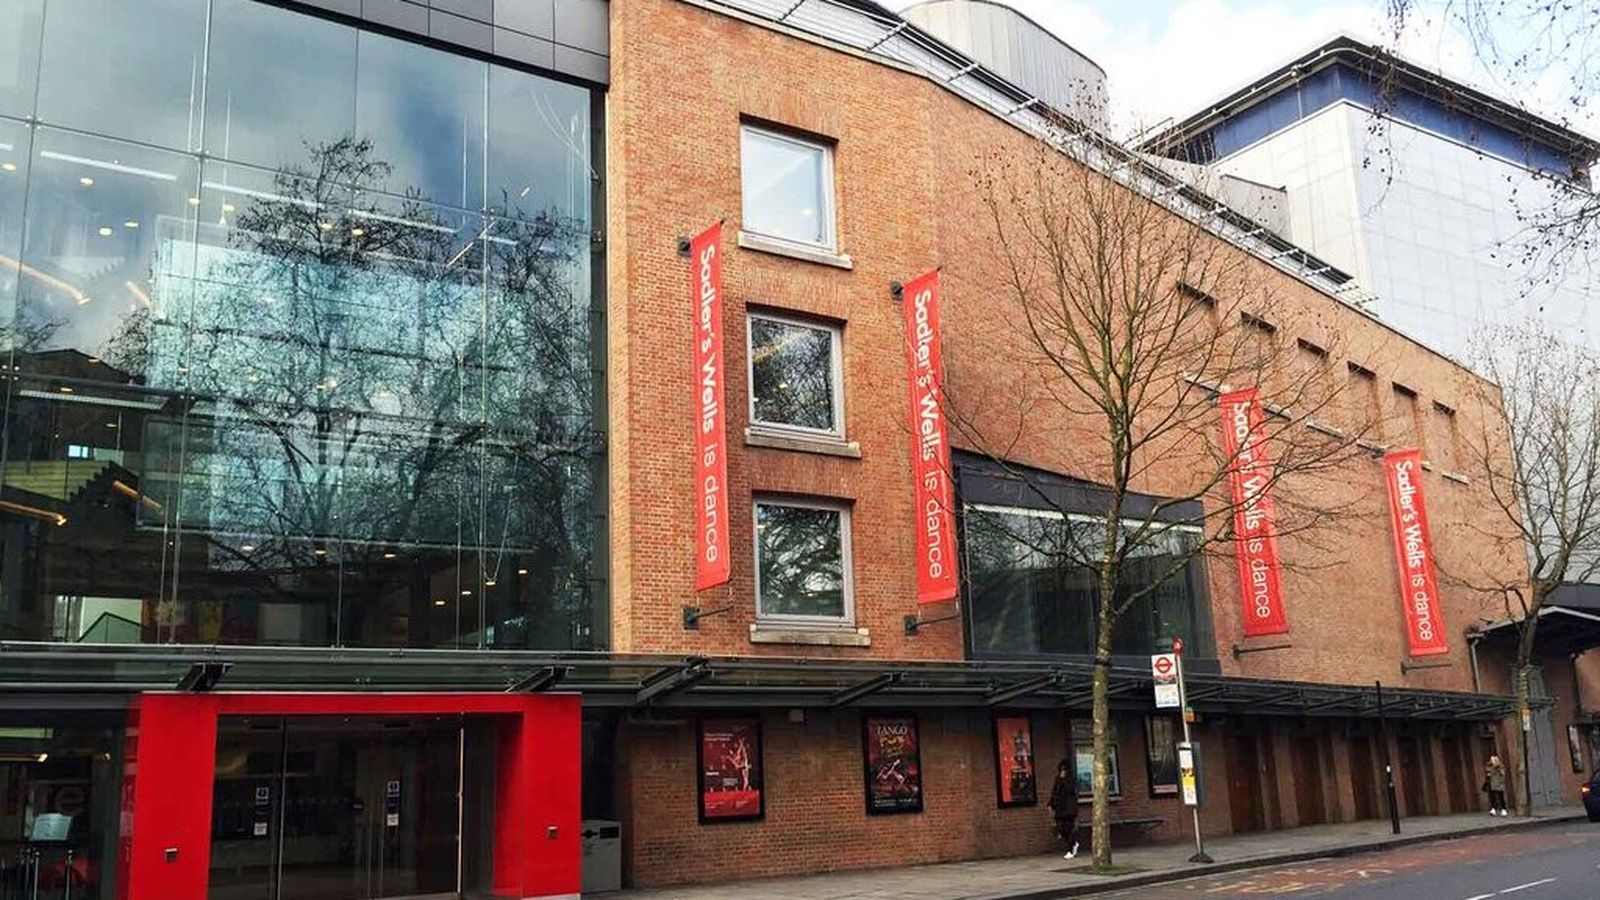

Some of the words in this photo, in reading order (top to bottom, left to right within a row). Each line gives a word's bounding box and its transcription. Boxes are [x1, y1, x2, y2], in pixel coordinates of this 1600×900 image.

[701, 244, 716, 353] Sadler's
[915, 289, 935, 388] Sadler's
[703, 353, 718, 434] Wells
[919, 388, 942, 462] Wells
[704, 443, 718, 467] is
[925, 470, 942, 492] is
[704, 475, 719, 563] dance
[1242, 476, 1265, 530] Wells
[1396, 460, 1418, 523] Sadler's
[926, 499, 943, 579] dance
[1248, 535, 1265, 554] is
[1405, 523, 1425, 569] Wells
[1251, 559, 1270, 618] dance
[1411, 573, 1427, 588] is
[1414, 591, 1433, 641] dance
